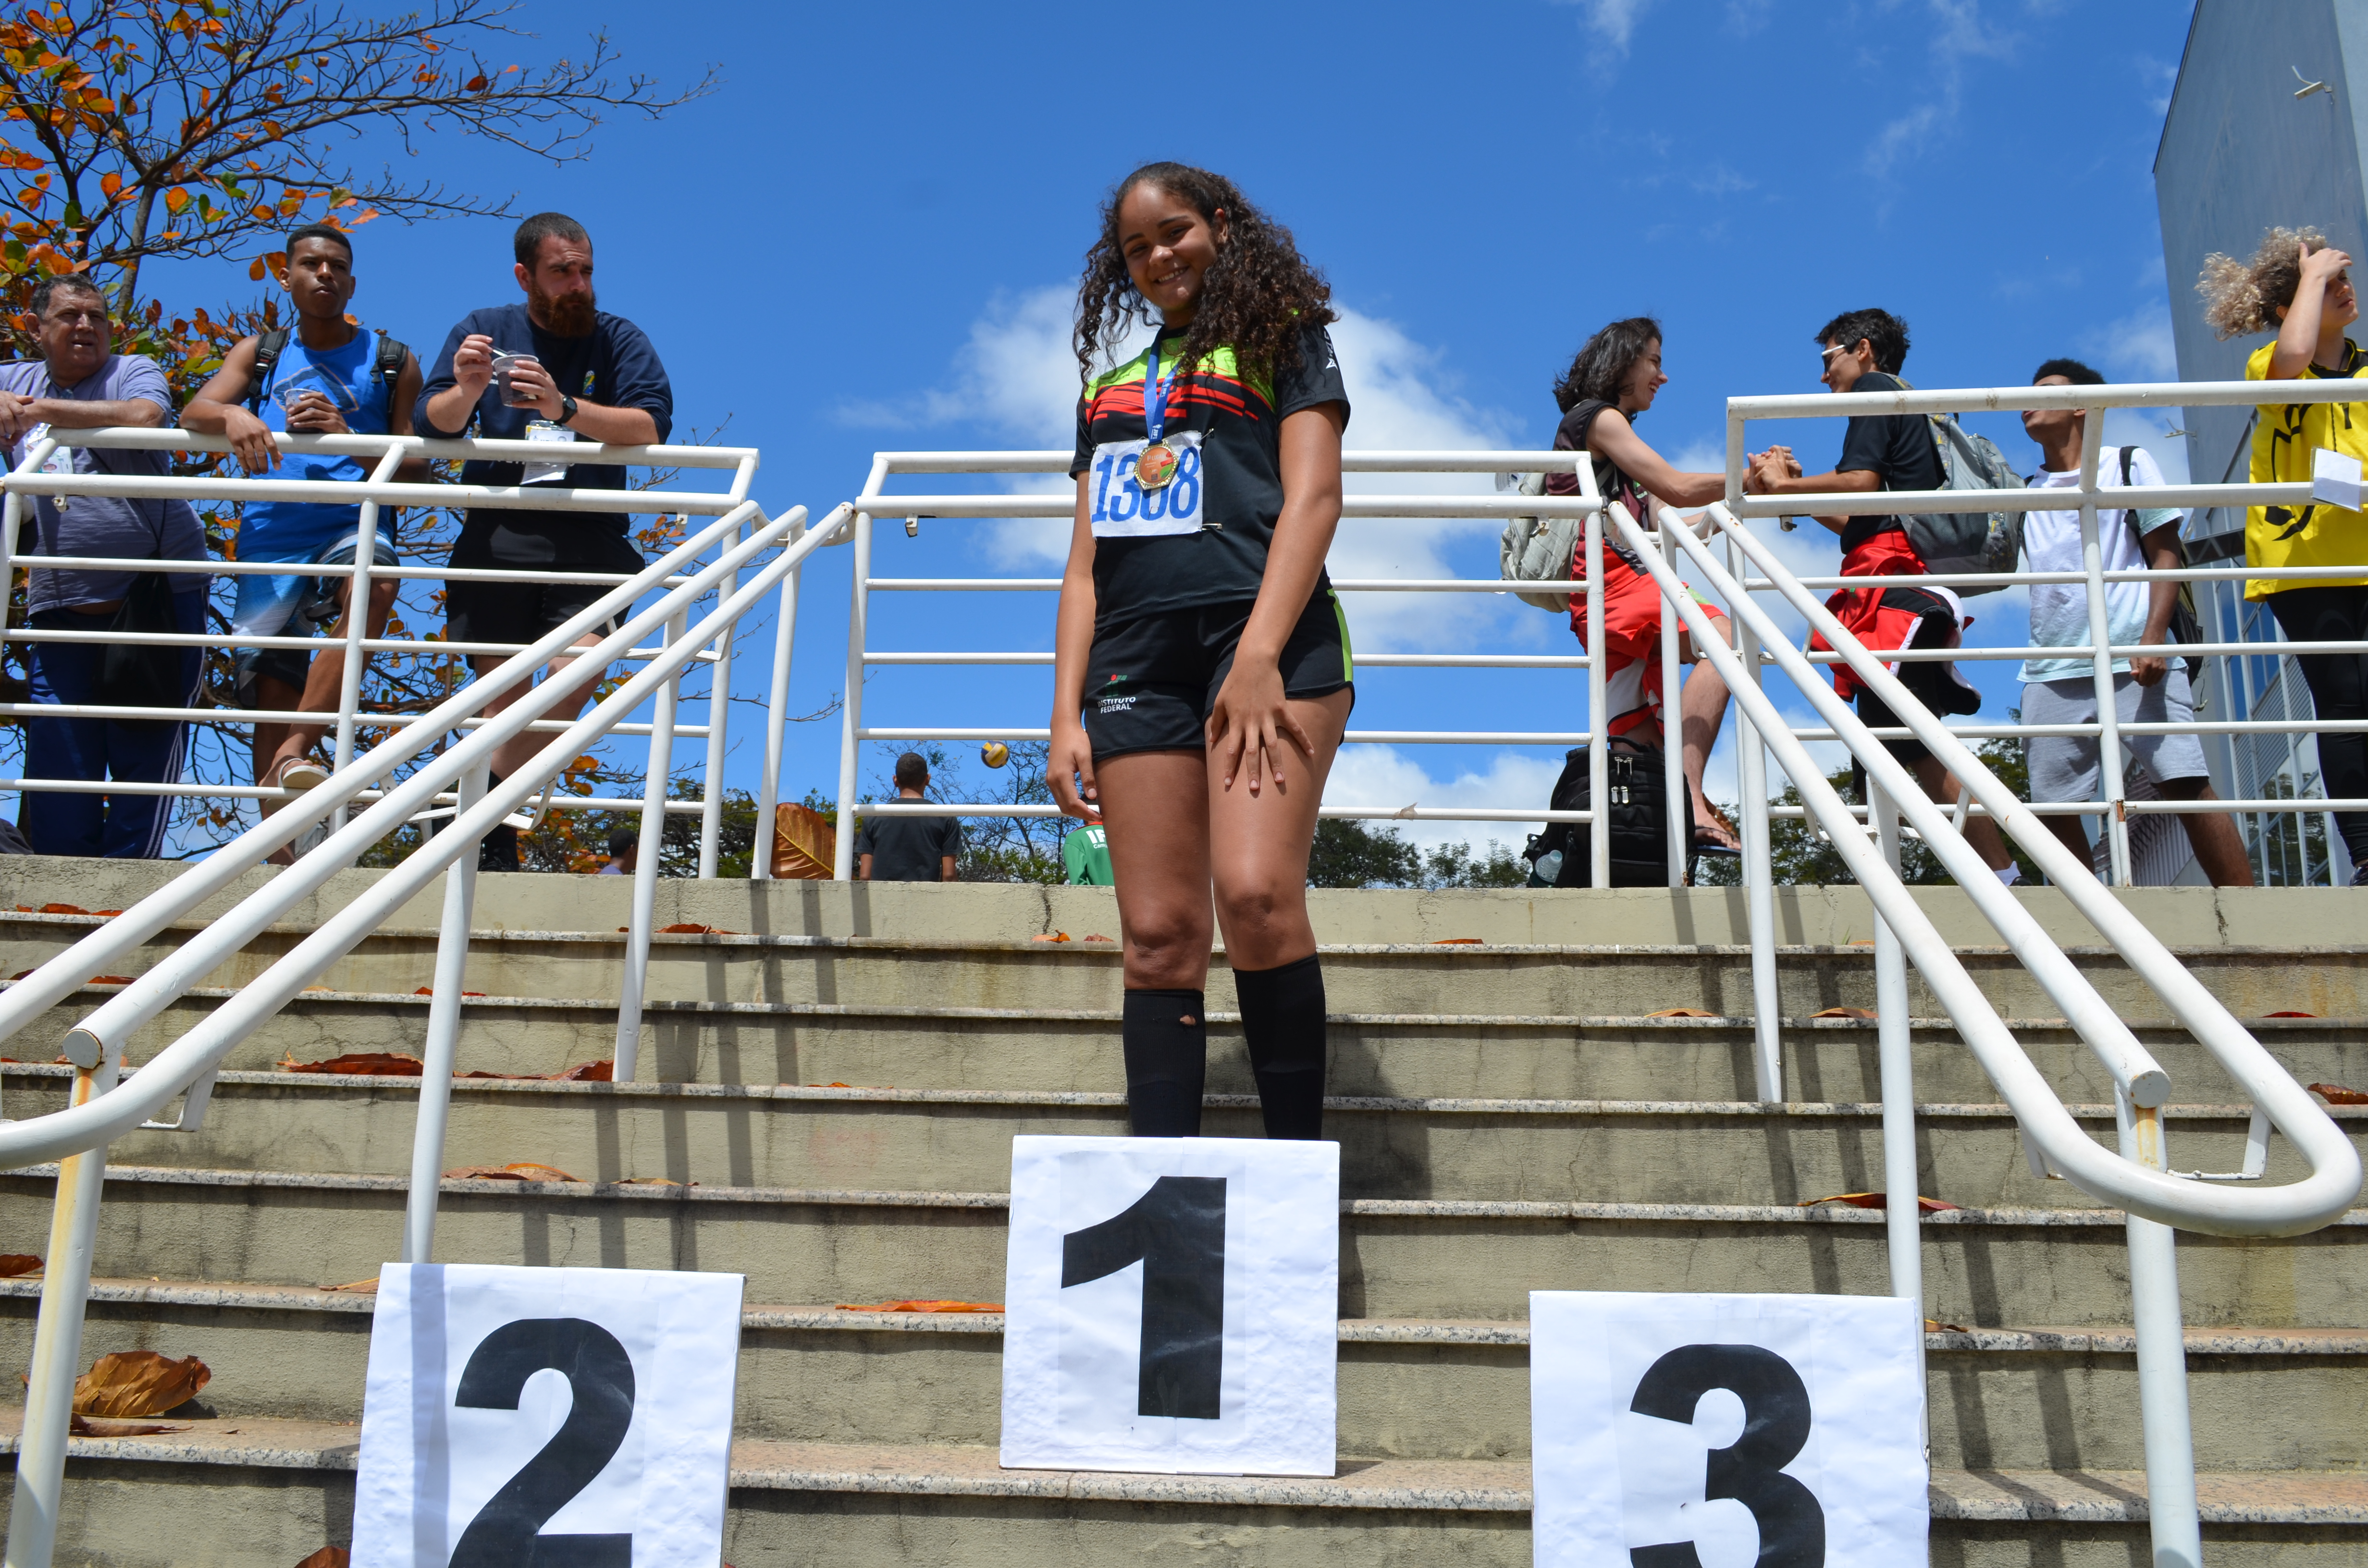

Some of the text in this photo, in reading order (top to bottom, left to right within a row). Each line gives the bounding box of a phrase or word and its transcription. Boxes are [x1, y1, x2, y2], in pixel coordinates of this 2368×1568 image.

[1097, 697, 1136, 708] INSTITUTO
[1100, 703, 1132, 714] FEDERAL
[1061, 1176, 1227, 1420] 1
[448, 1317, 636, 1568] 2
[1629, 1343, 1825, 1568] 3
